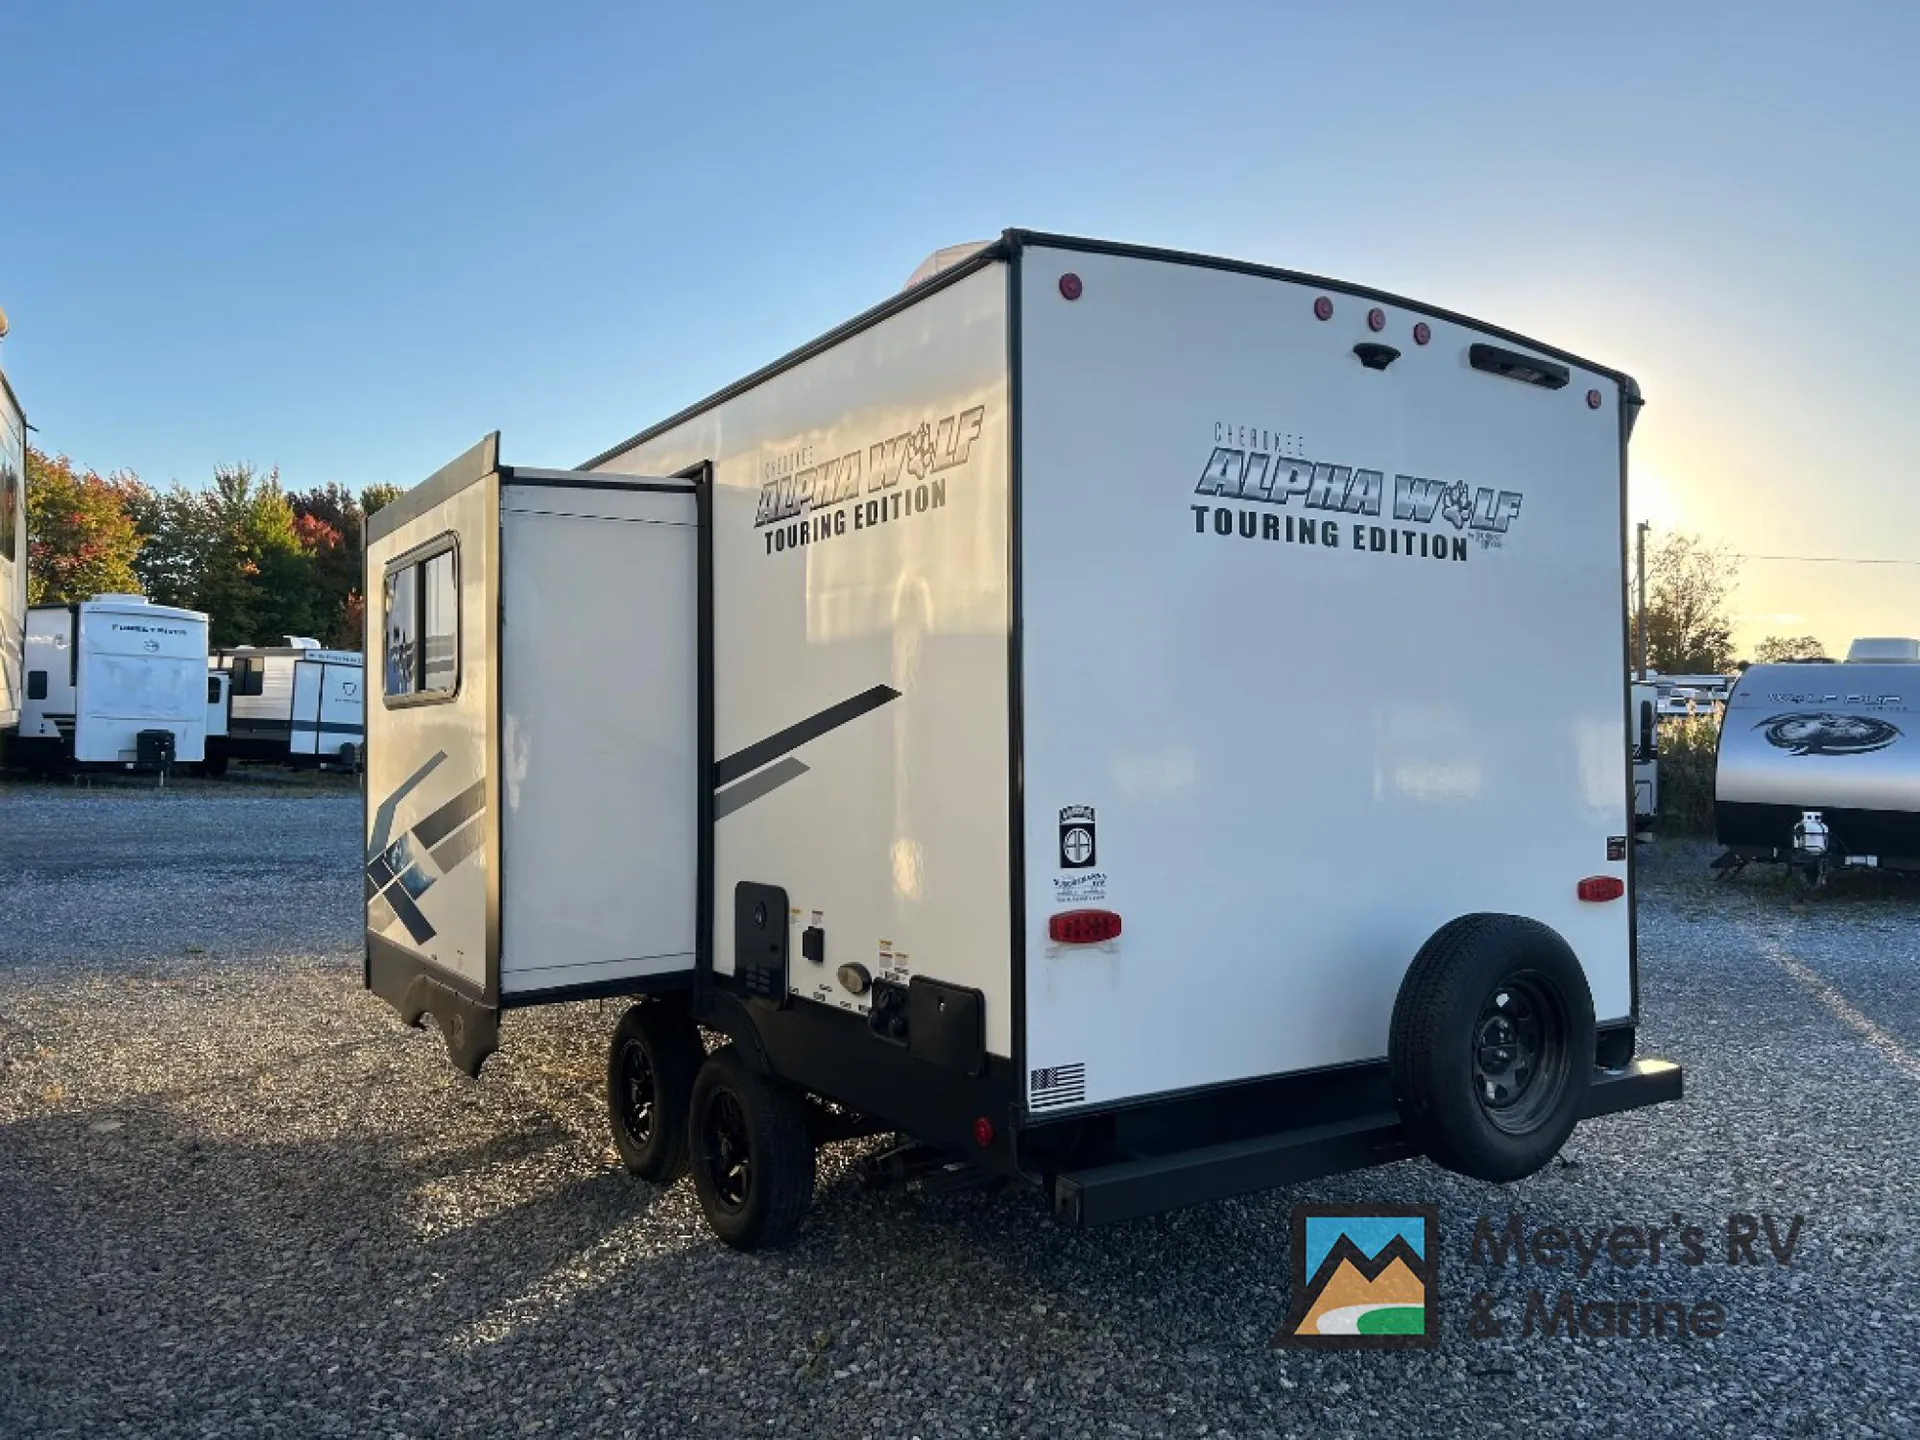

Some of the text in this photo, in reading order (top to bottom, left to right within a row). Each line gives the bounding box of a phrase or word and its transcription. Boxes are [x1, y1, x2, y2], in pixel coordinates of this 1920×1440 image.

[1213, 421, 1305, 457] CHEROKEE
[754, 449, 862, 528] ALPHA
[764, 477, 947, 555] TOURING EDITION
[1193, 446, 1524, 533] ALPHA WOLF
[1190, 503, 1340, 549] TOURING
[1353, 524, 1468, 562] EDITION
